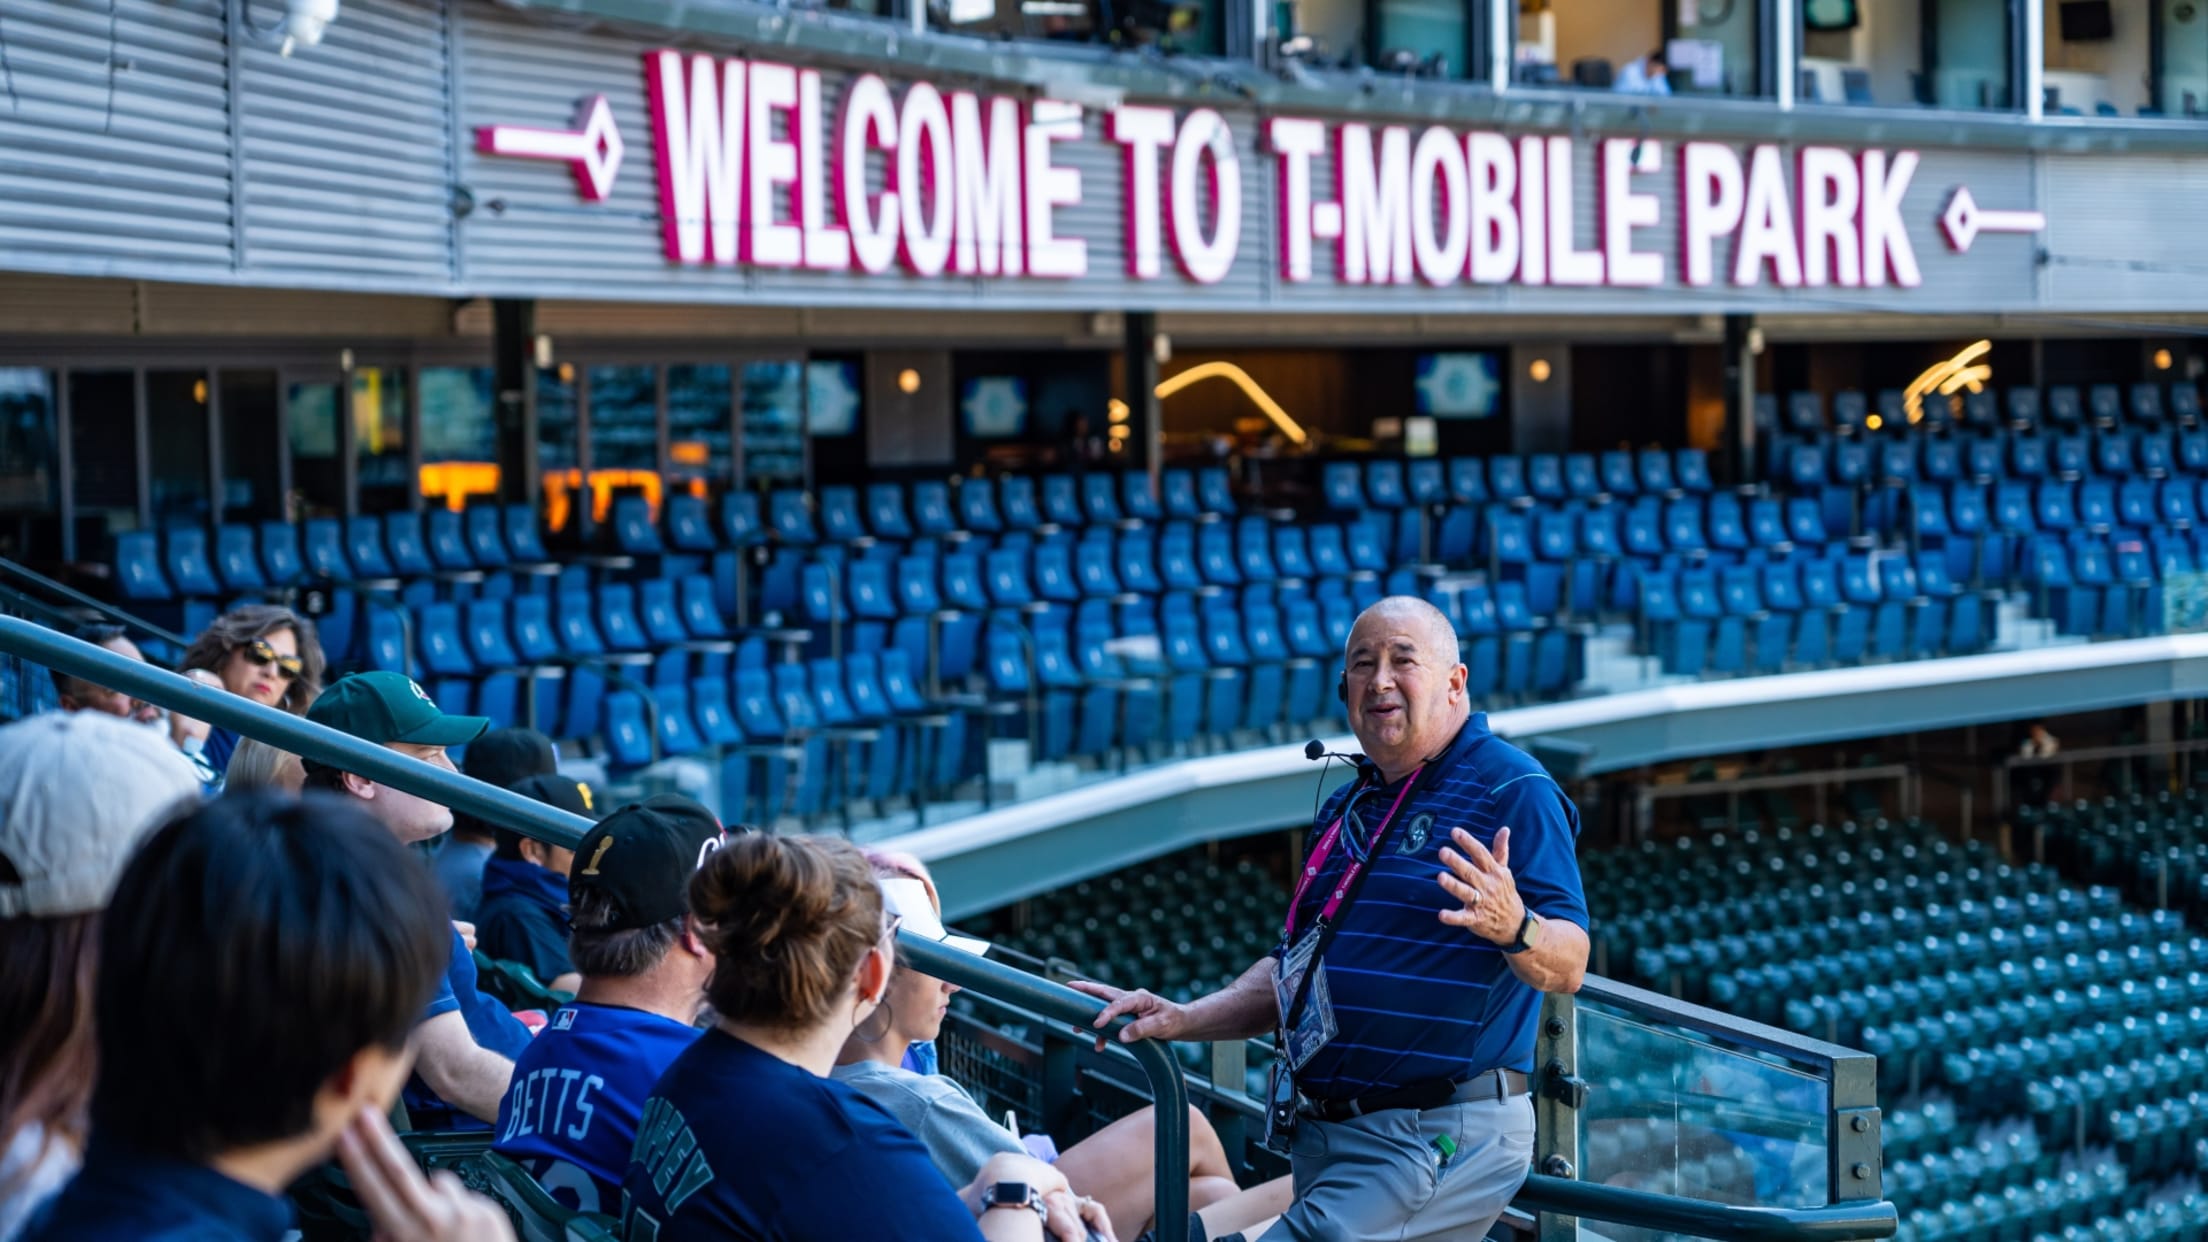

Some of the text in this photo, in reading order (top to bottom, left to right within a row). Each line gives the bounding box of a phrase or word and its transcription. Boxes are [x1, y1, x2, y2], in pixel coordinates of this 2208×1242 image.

[645, 50, 1921, 288] WELCOME TO T-MOBILE PARK
[501, 1067, 604, 1144] BETTS
